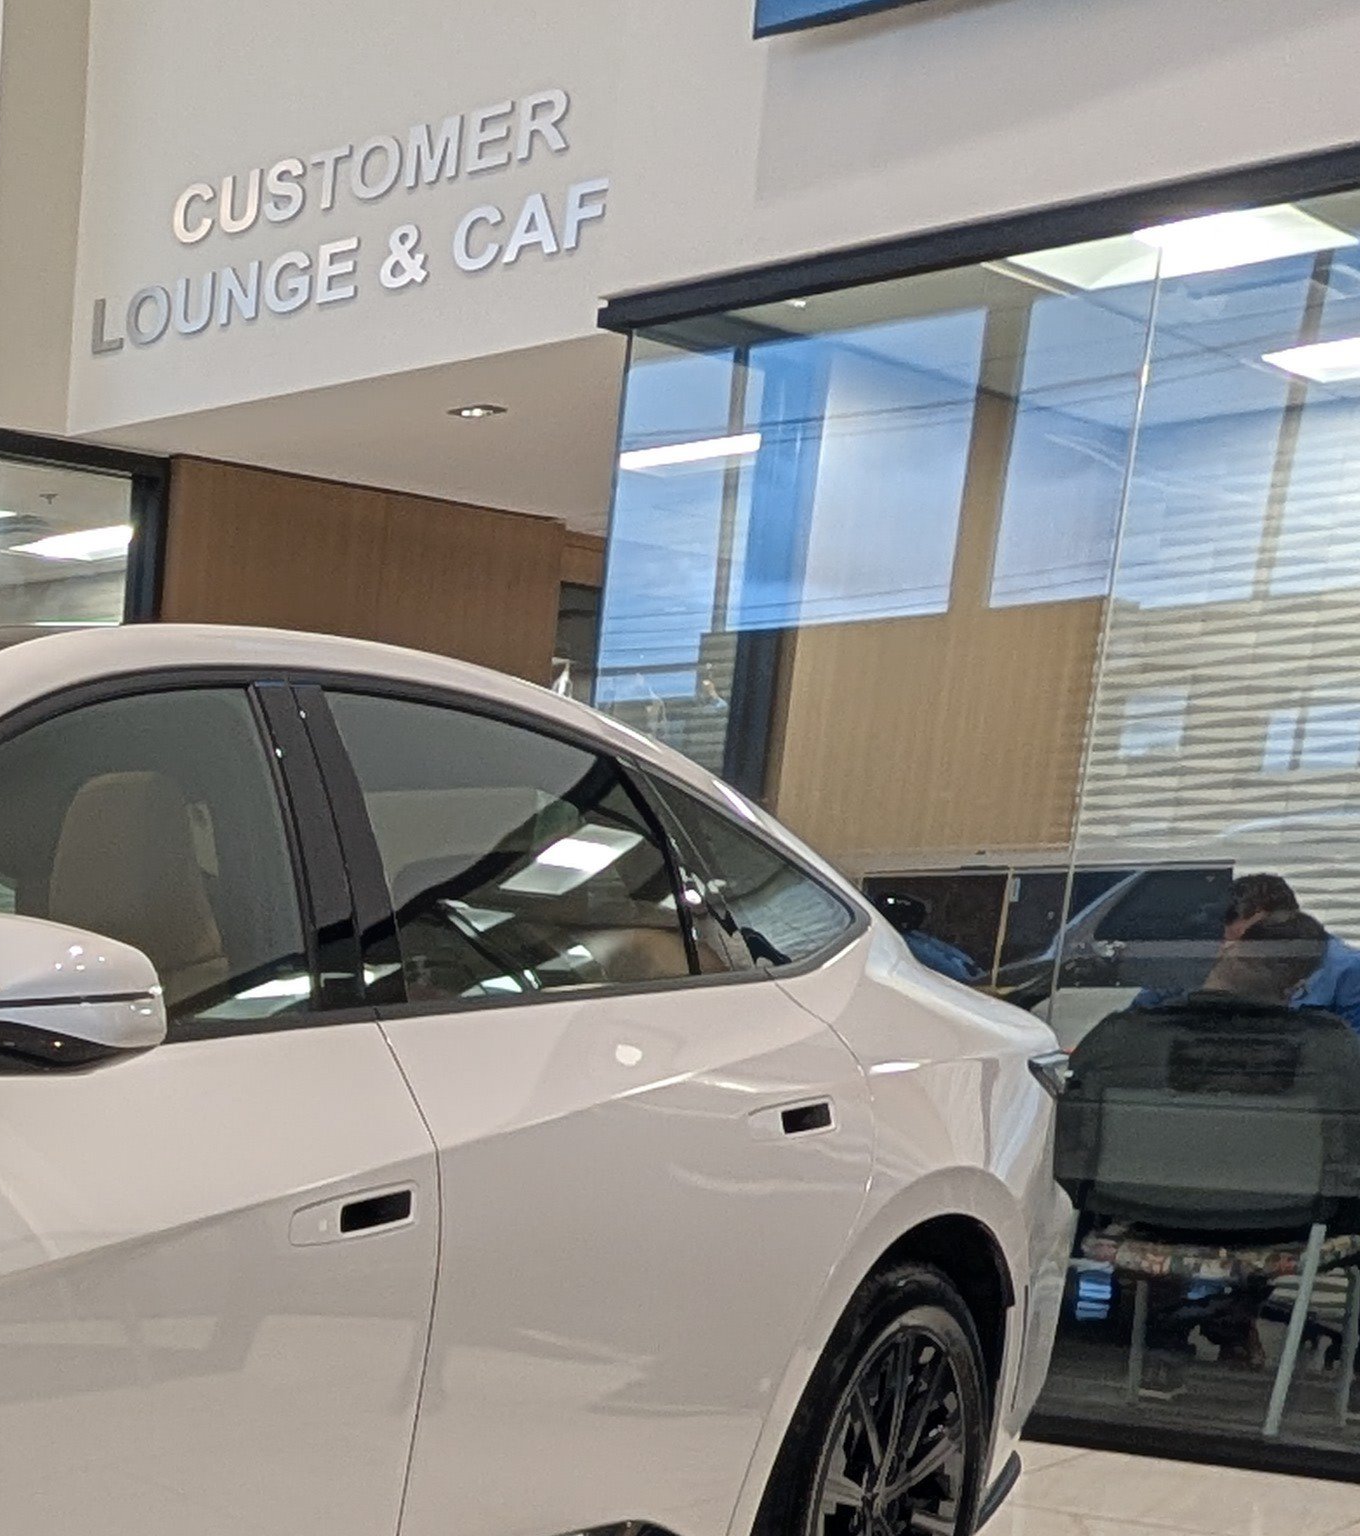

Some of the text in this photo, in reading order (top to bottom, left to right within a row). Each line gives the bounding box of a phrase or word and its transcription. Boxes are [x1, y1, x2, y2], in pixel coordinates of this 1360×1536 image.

[173, 88, 570, 245] CUSTOMER
[91, 177, 611, 355] LOUNGE & CAF
